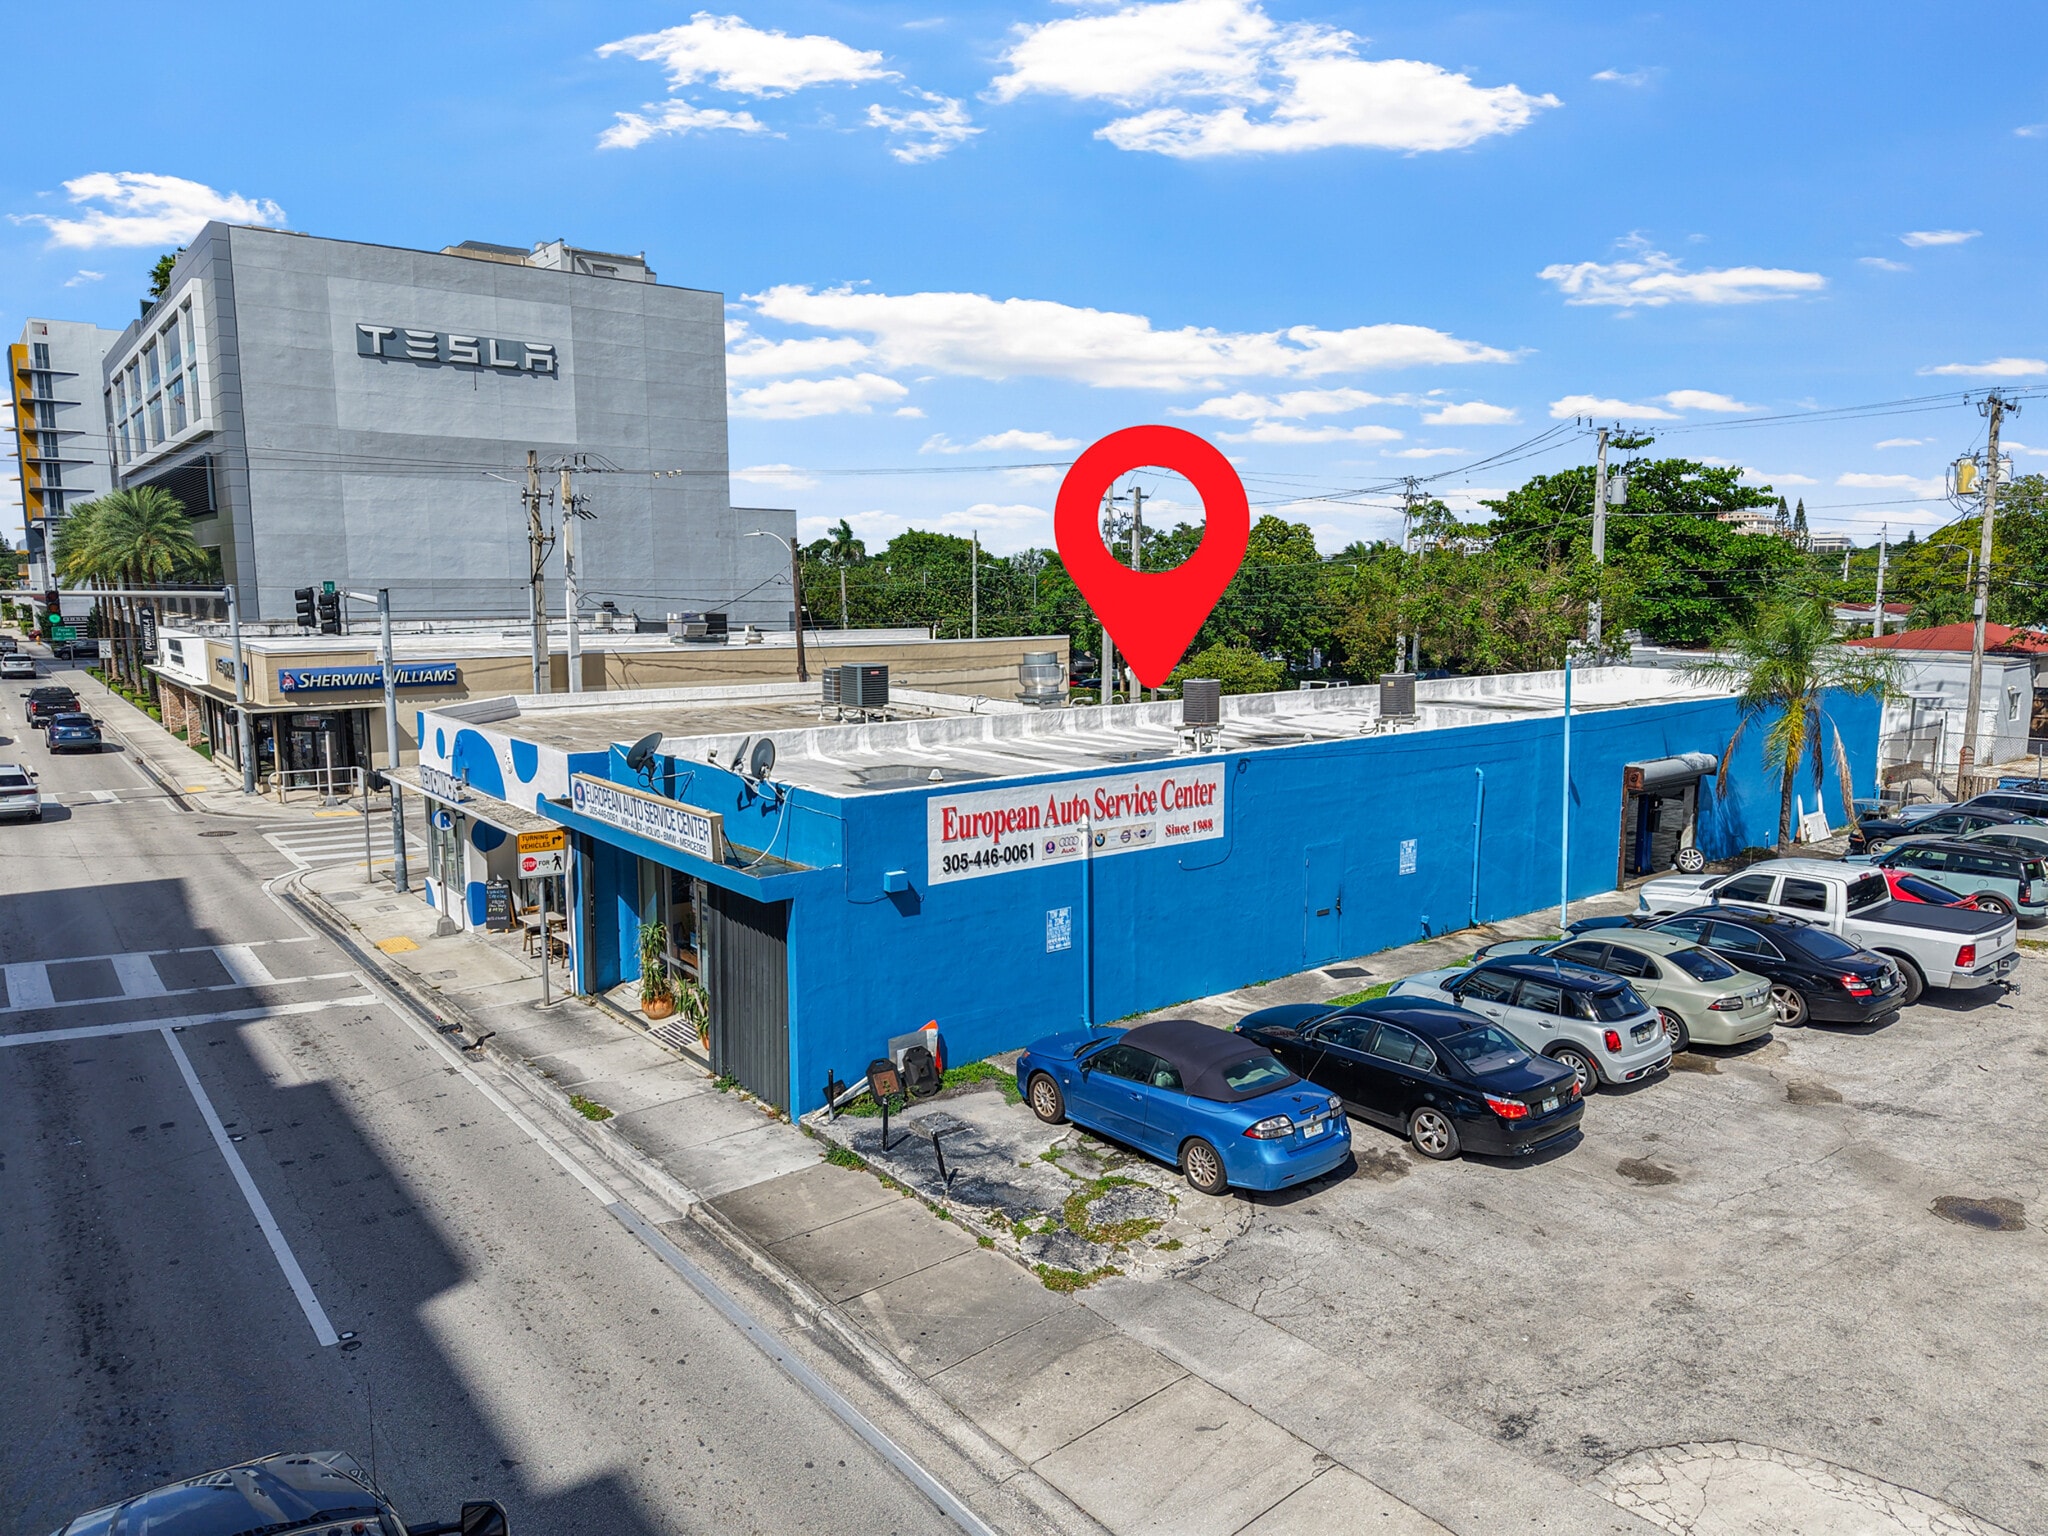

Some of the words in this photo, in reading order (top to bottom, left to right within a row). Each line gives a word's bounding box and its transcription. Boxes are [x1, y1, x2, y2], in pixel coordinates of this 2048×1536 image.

[357, 324, 553, 372] TESLA
[440, 812, 451, 828] R
[585, 783, 622, 814] EUROPEAN
[623, 795, 643, 821] AUTO
[644, 802, 676, 831] SERVICE
[677, 812, 709, 843] CENTER
[941, 804, 1040, 845] European
[1043, 793, 1091, 828] Auto
[1094, 783, 1158, 821] Service
[1161, 778, 1217, 811] Center
[1165, 823, 1190, 837] Since
[1192, 818, 1214, 833] 1988
[942, 842, 1035, 873] 305-446-0061
